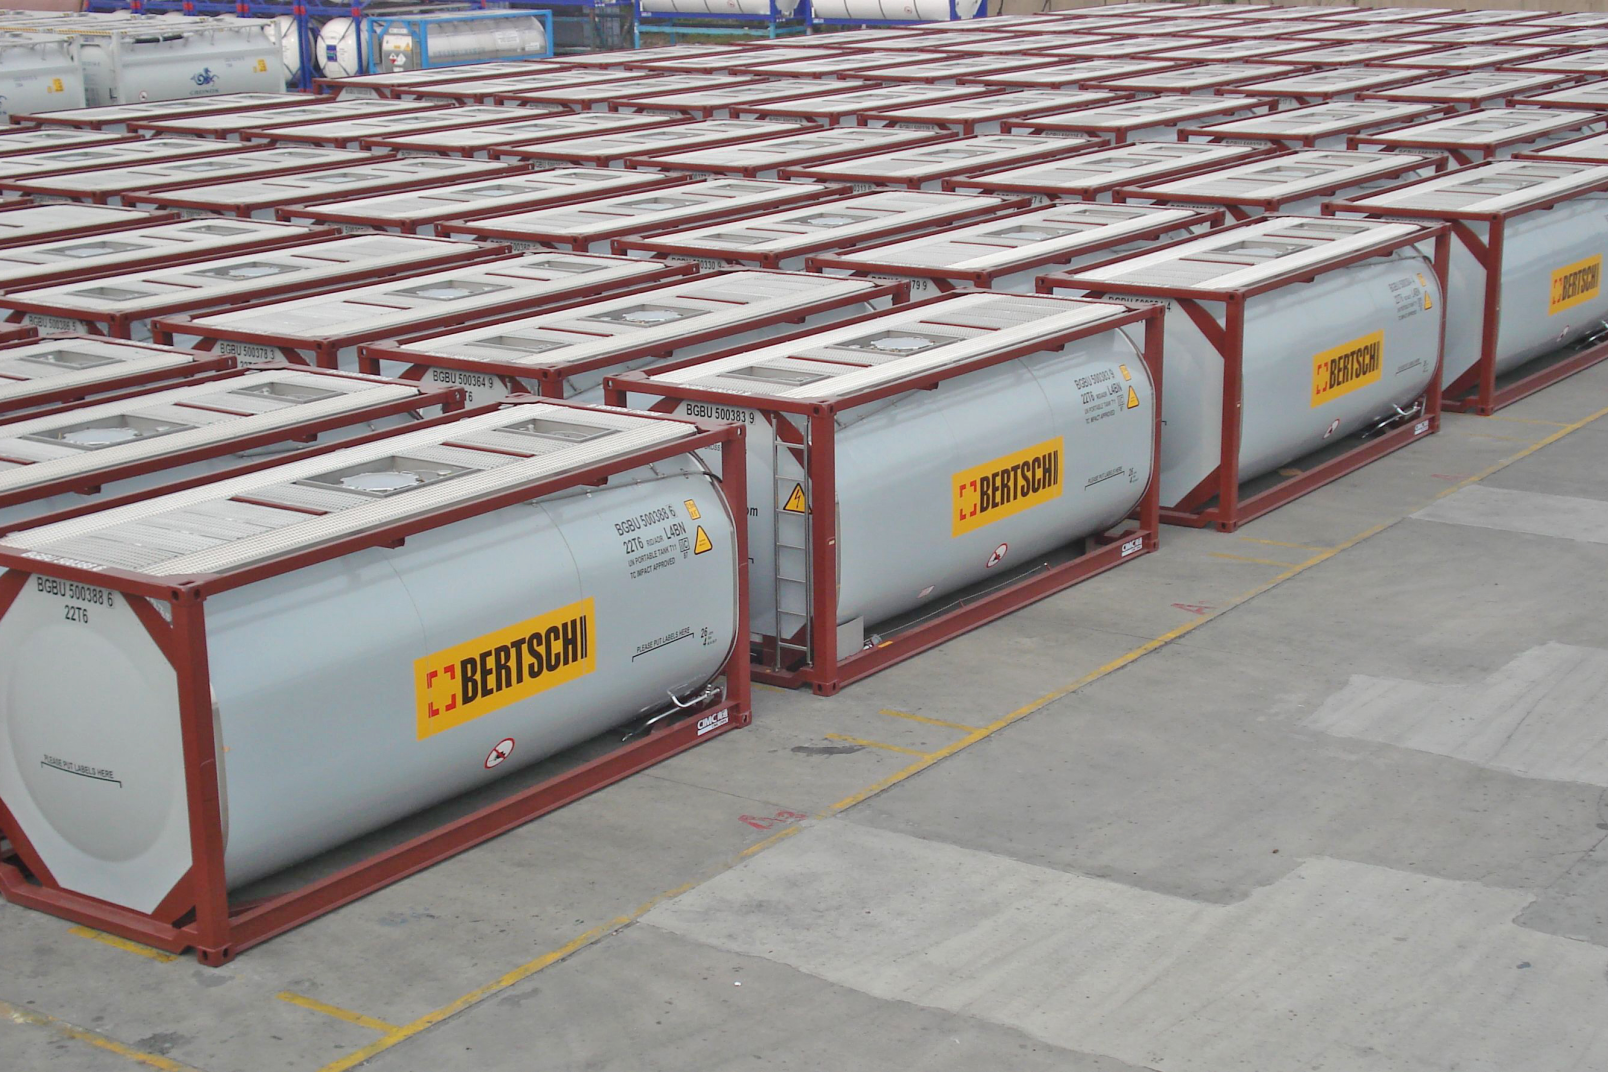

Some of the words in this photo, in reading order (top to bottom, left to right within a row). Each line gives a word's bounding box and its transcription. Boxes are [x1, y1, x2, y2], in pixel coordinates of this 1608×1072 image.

[1562, 262, 1600, 301] BERTSCHI
[29, 315, 47, 328] BGBU
[220, 343, 242, 355] BGBU
[243, 345, 268, 359] 500378
[270, 350, 275, 360] 3
[1329, 340, 1380, 390] BERTSCHI
[432, 370, 457, 383] BGBU
[458, 373, 486, 388] 500364
[488, 377, 494, 389] 9
[1074, 374, 1093, 390] BGBU
[686, 403, 713, 418] BGBU
[715, 407, 747, 423] 500383
[749, 412, 755, 424] 9
[980, 450, 1059, 514] BERTSCHI
[614, 517, 641, 536] BGBU
[640, 507, 670, 527] 500388
[669, 505, 676, 517] 6
[623, 537, 644, 554] 22T6
[663, 521, 687, 540] L4BN
[634, 550, 658, 565] PORTABLE
[657, 546, 670, 557] TANK
[636, 565, 653, 577] IMPACT
[652, 557, 676, 572] APPROVED
[37, 577, 66, 597] BGBU
[69, 584, 104, 605] 500388
[107, 592, 113, 607] 6
[64, 605, 88, 623] 22T6
[636, 641, 653, 653] PLEASE
[653, 637, 662, 646] PUT
[662, 631, 679, 643] LABELS
[679, 626, 690, 637] HERE
[460, 614, 588, 706] BERTSCHI
[44, 754, 63, 767] PLEASE
[63, 761, 73, 770] PUT
[74, 763, 96, 775] LABELS
[97, 769, 114, 779] HERE
